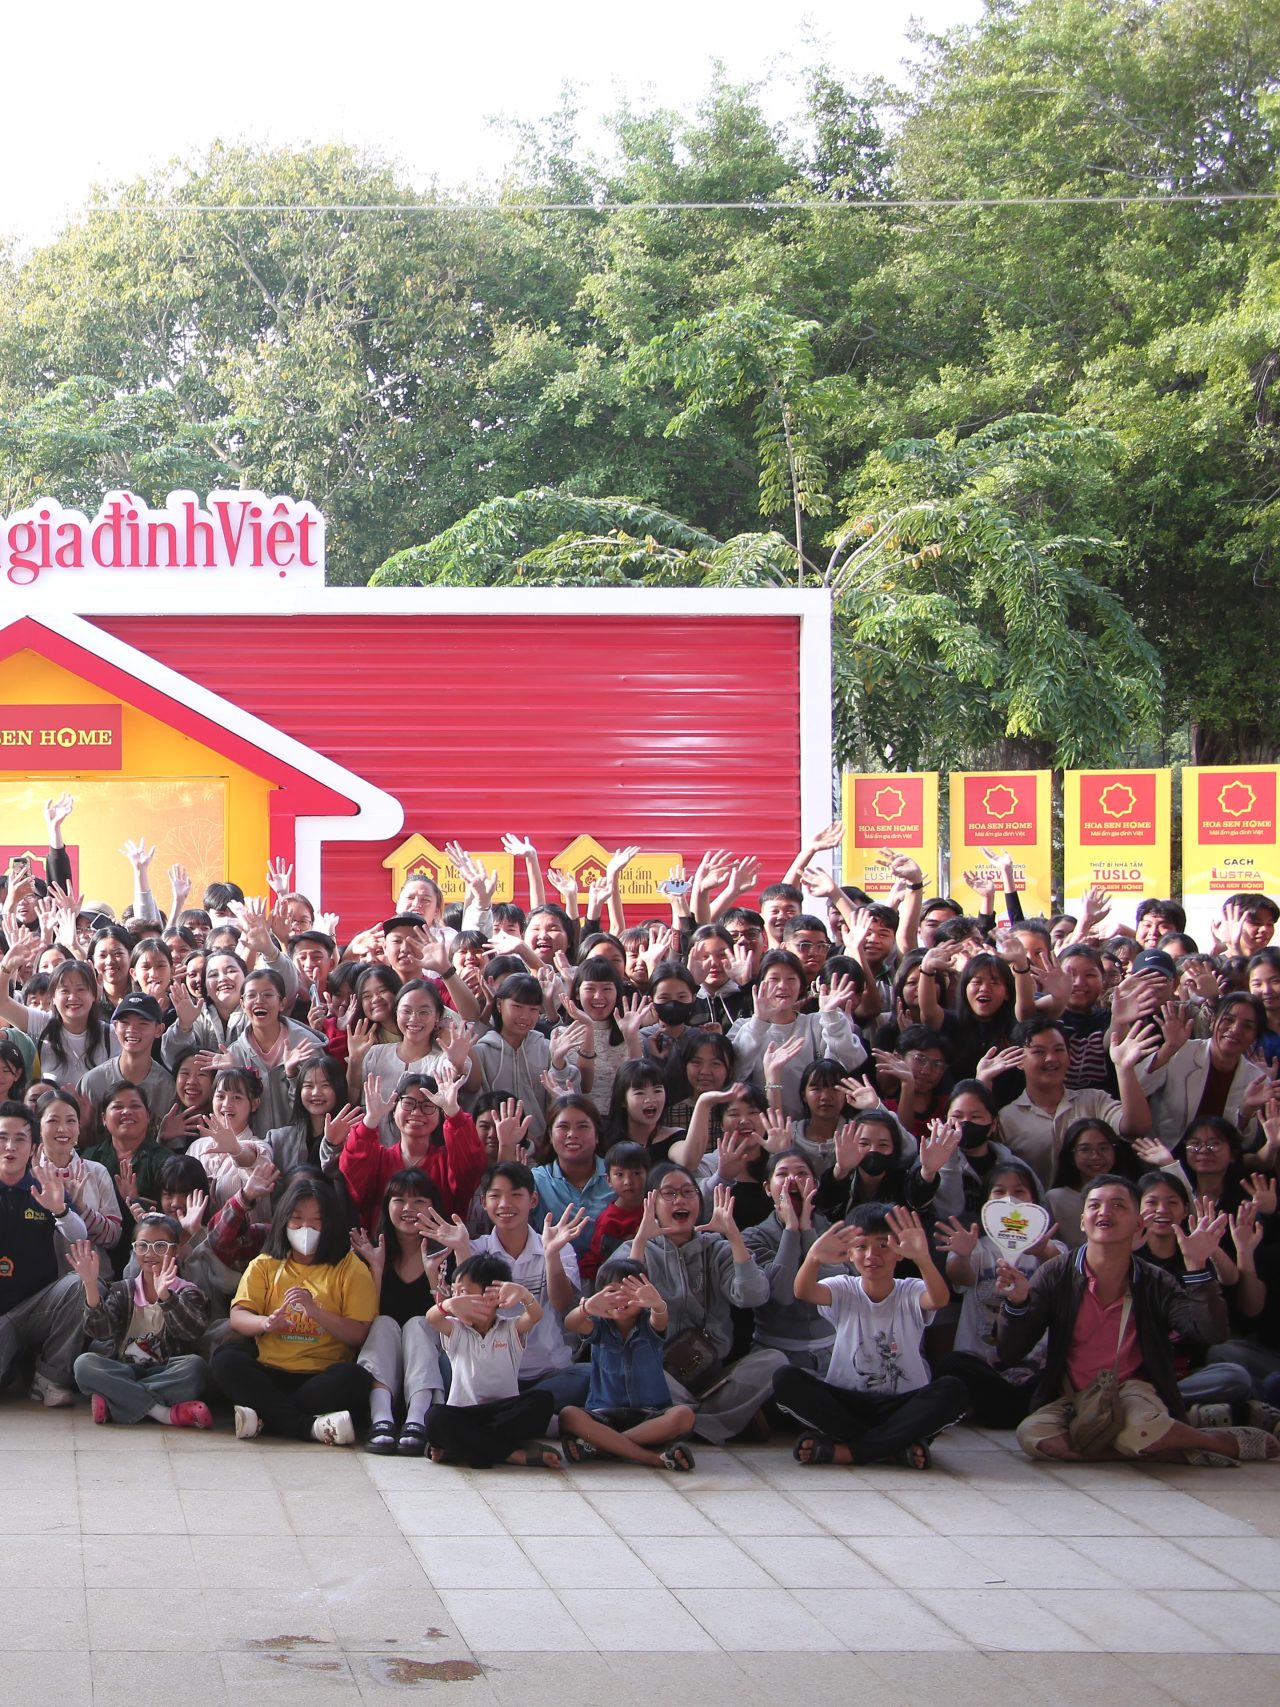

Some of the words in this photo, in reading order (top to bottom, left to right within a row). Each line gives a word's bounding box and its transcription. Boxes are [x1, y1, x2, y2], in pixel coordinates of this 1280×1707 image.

[7, 509, 84, 586] gia
[91, 493, 218, 568] đình
[213, 501, 318, 578] Việt
[40, 727, 112, 748] HOME
[636, 866, 652, 880] ấm
[1094, 870, 1141, 880] TUSLO
[441, 881, 456, 895] gia
